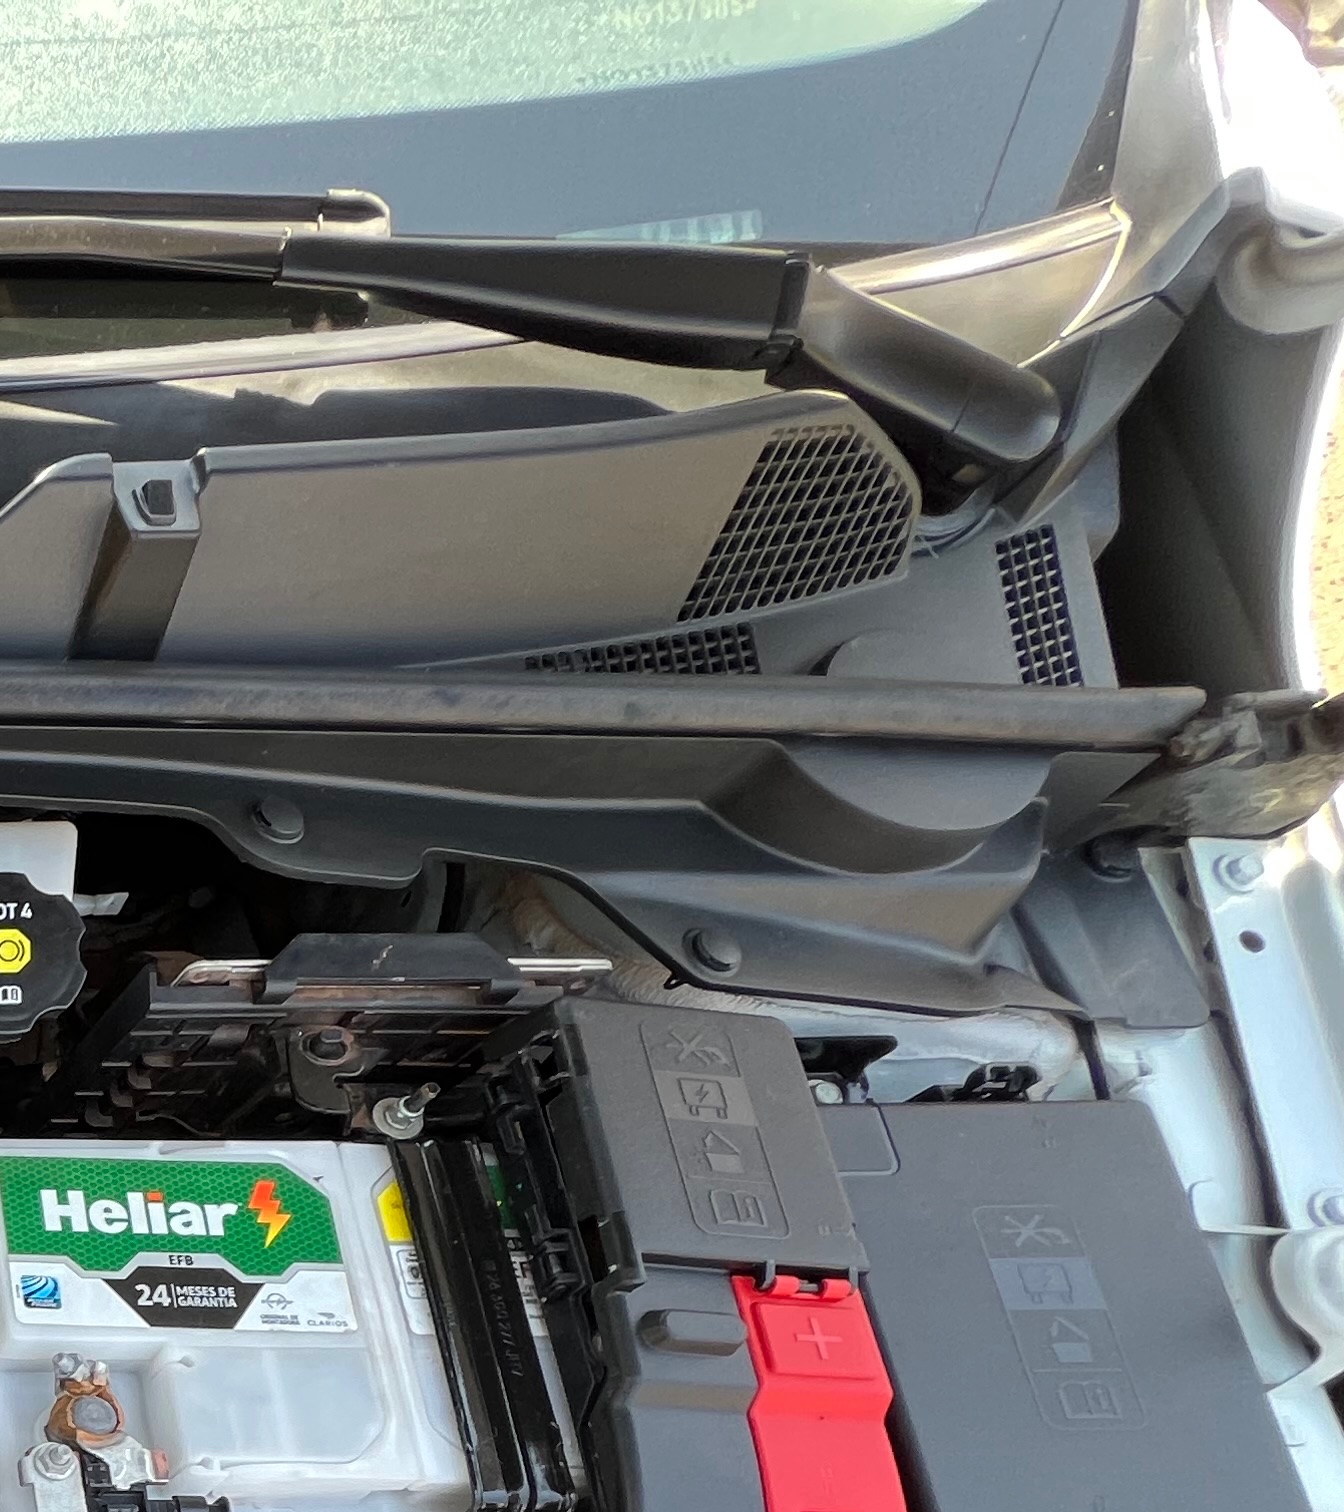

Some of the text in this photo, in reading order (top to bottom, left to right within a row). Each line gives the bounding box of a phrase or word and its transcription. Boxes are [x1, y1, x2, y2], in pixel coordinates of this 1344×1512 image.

[20, 902, 33, 919] 4
[39, 1188, 239, 1237] Heliar
[168, 1254, 194, 1266] EFB
[134, 1283, 236, 1308] 24 MESES DE
[176, 1296, 238, 1309] GARANTIA
[307, 1319, 349, 1328] CLARIOS
